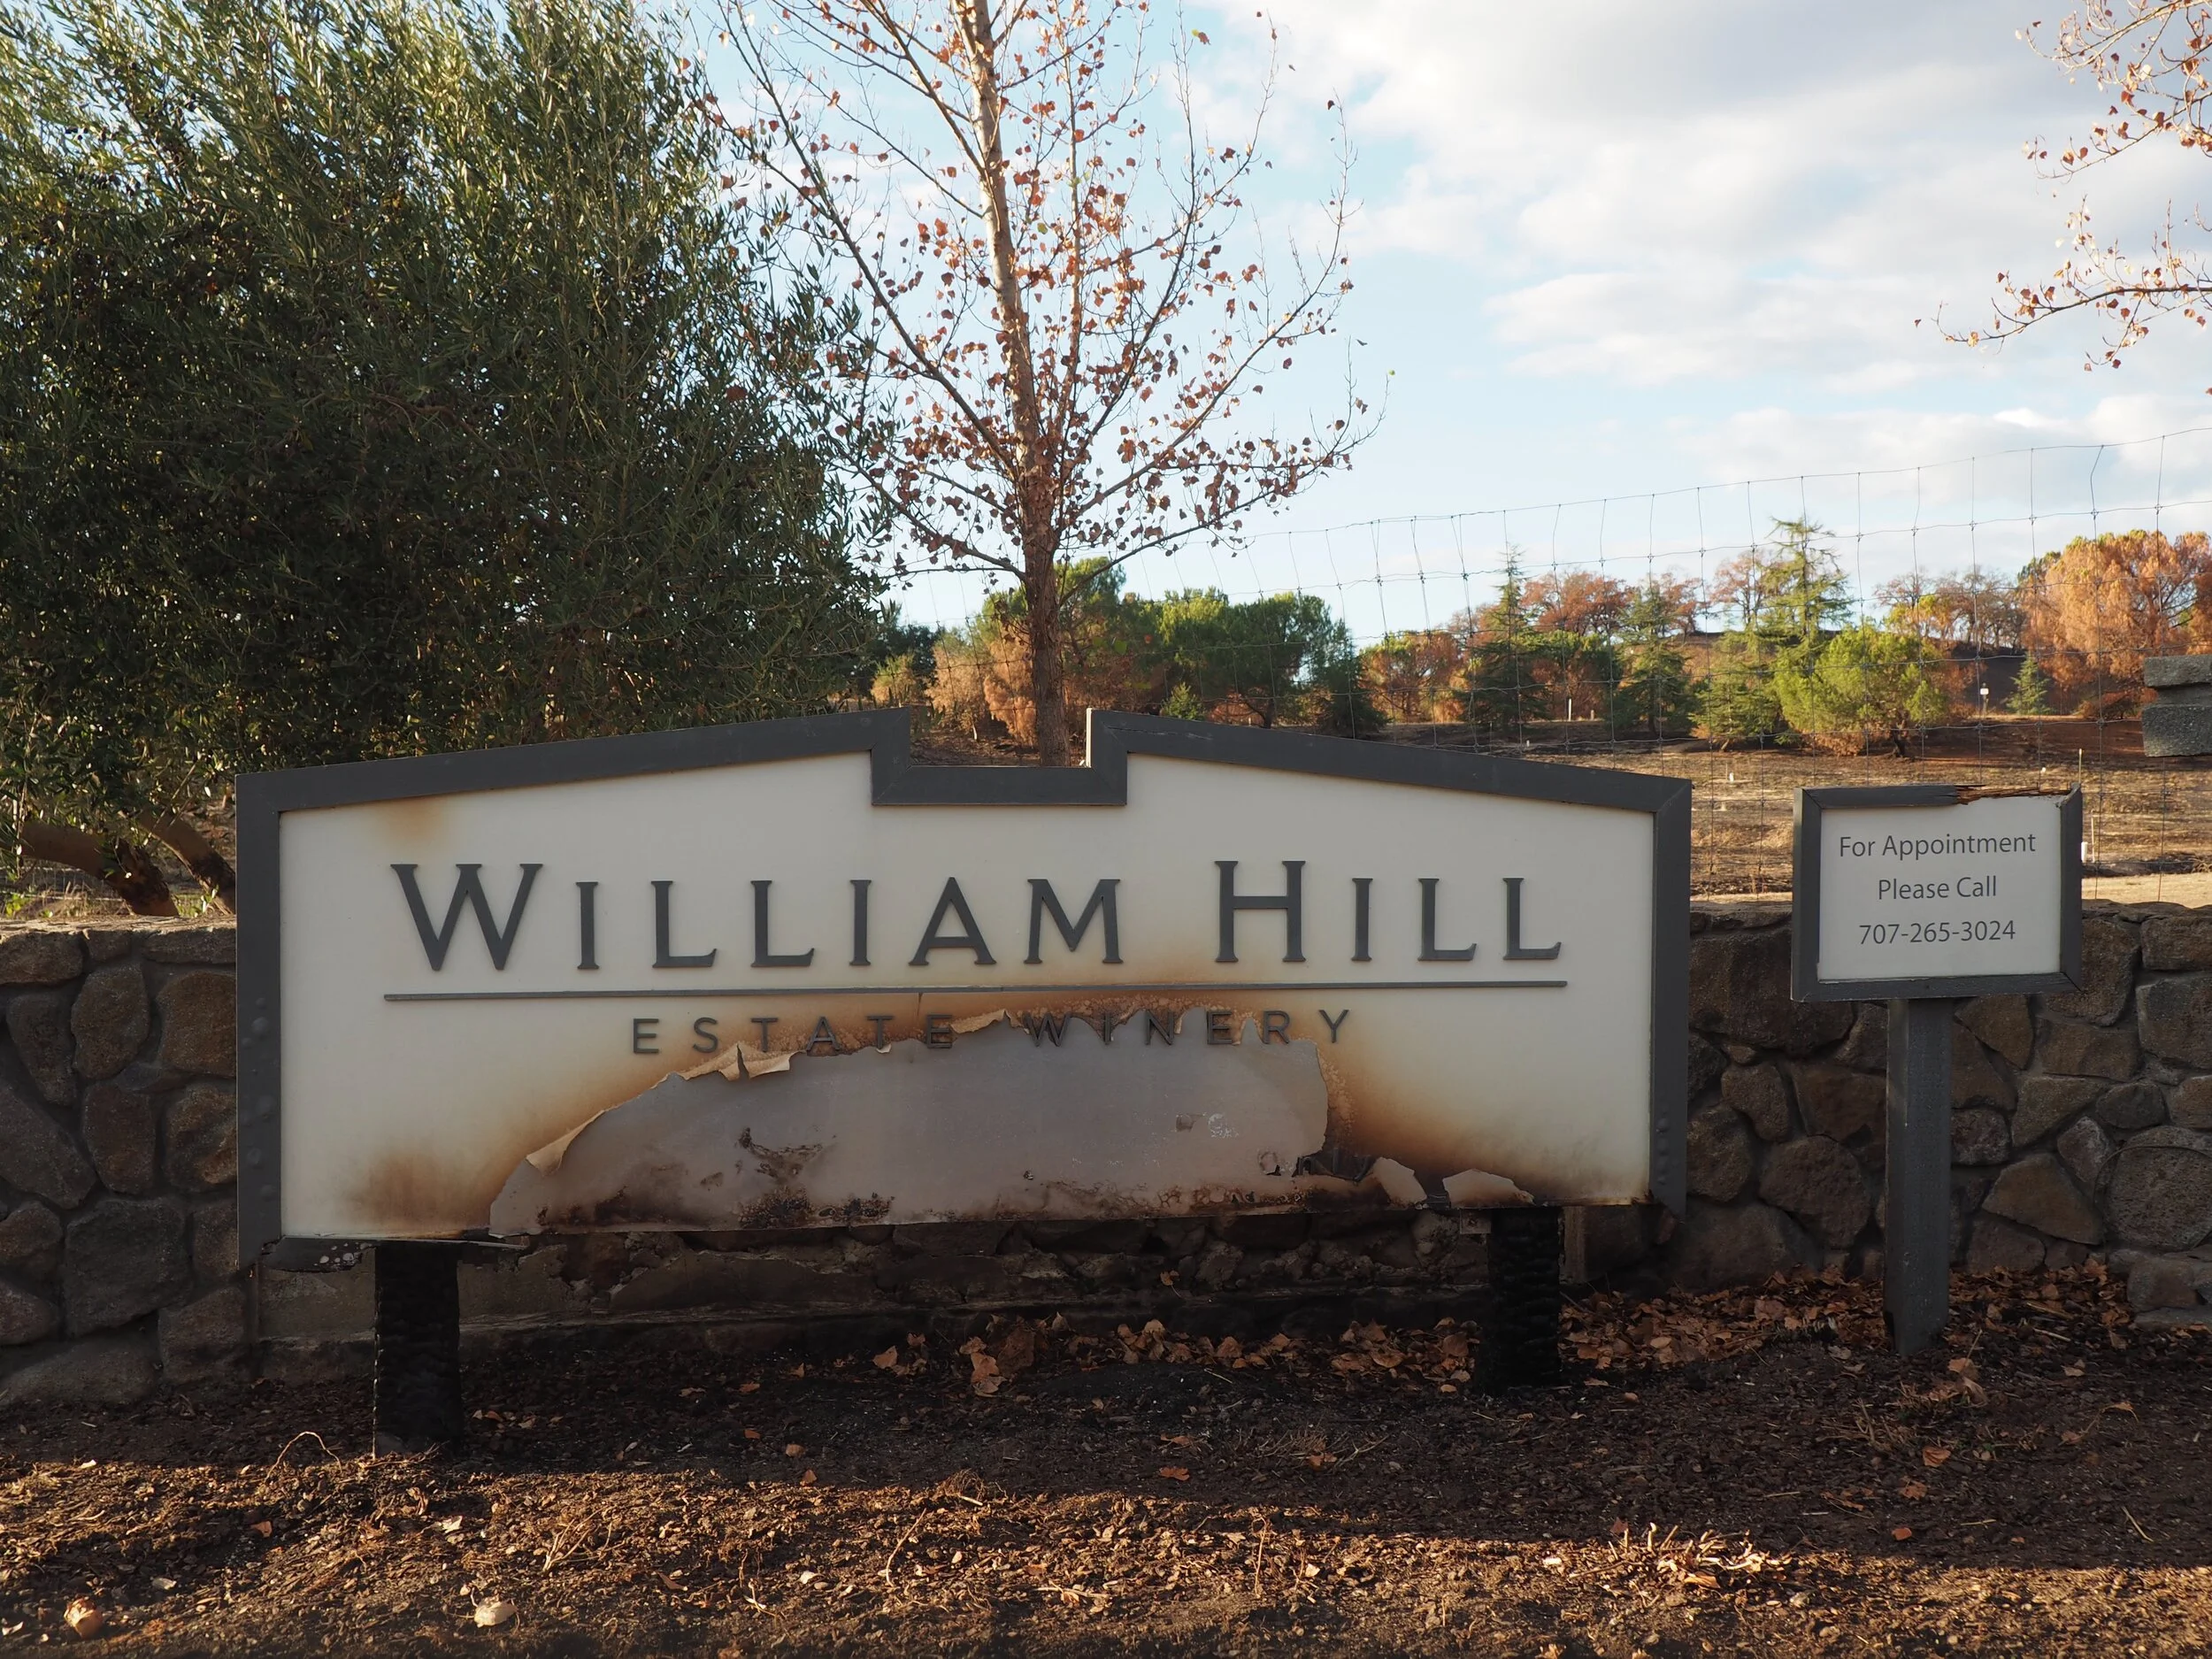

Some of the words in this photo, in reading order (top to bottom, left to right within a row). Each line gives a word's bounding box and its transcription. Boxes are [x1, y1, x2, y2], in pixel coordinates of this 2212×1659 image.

[1839, 836, 1875, 856] For
[1882, 833, 2036, 860] Appointment
[1878, 879, 1949, 900] Please
[1956, 875, 1996, 897] Call
[390, 863, 1124, 972] WILLIAM
[1214, 860, 1562, 964] HILL
[1859, 920, 2016, 944] 707-265-3024
[632, 1014, 954, 1057] ESTATE
[1023, 1009, 1350, 1048] WINERY
